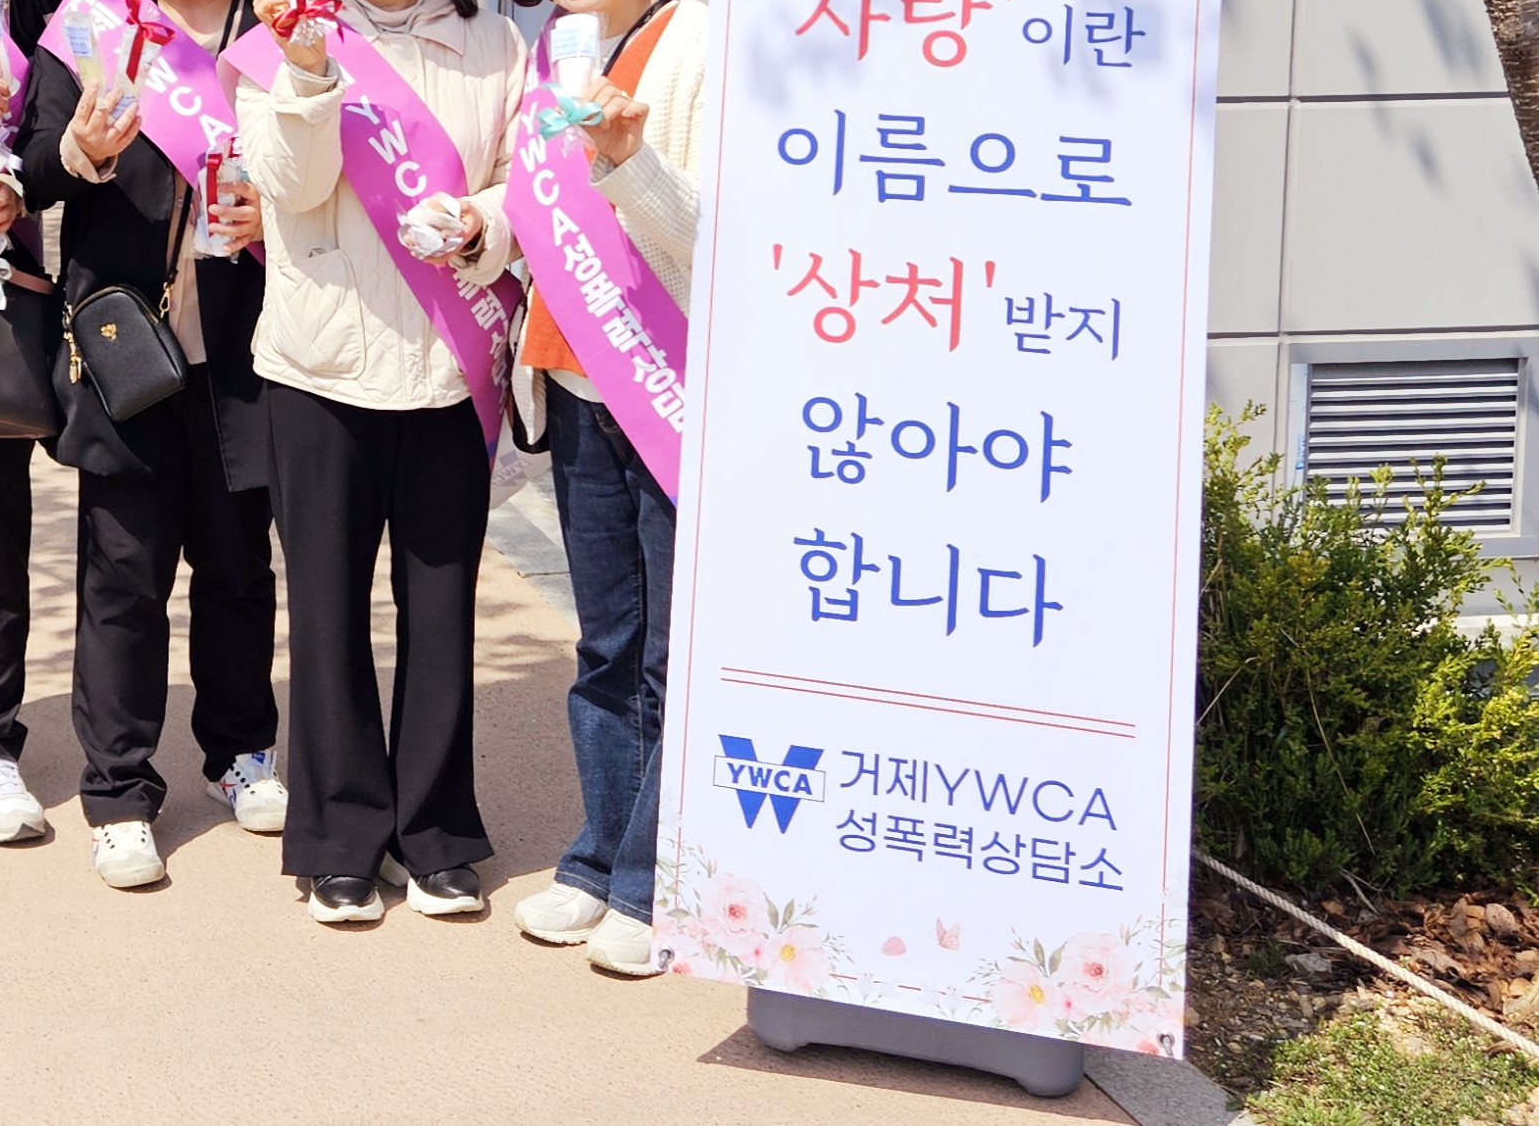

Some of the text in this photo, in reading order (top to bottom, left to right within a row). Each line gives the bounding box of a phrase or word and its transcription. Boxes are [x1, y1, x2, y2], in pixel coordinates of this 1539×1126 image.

[777, 109, 1132, 206] 이름으로
[519, 69, 579, 248] YWCA
[563, 233, 686, 434] 성폭력상담
[802, 392, 1073, 502] 않아야
[793, 527, 1064, 648] 합니다
[726, 760, 814, 796] YWCA
[839, 750, 1118, 831] 거제YWCA
[836, 808, 1124, 892] 성폭력상담소
